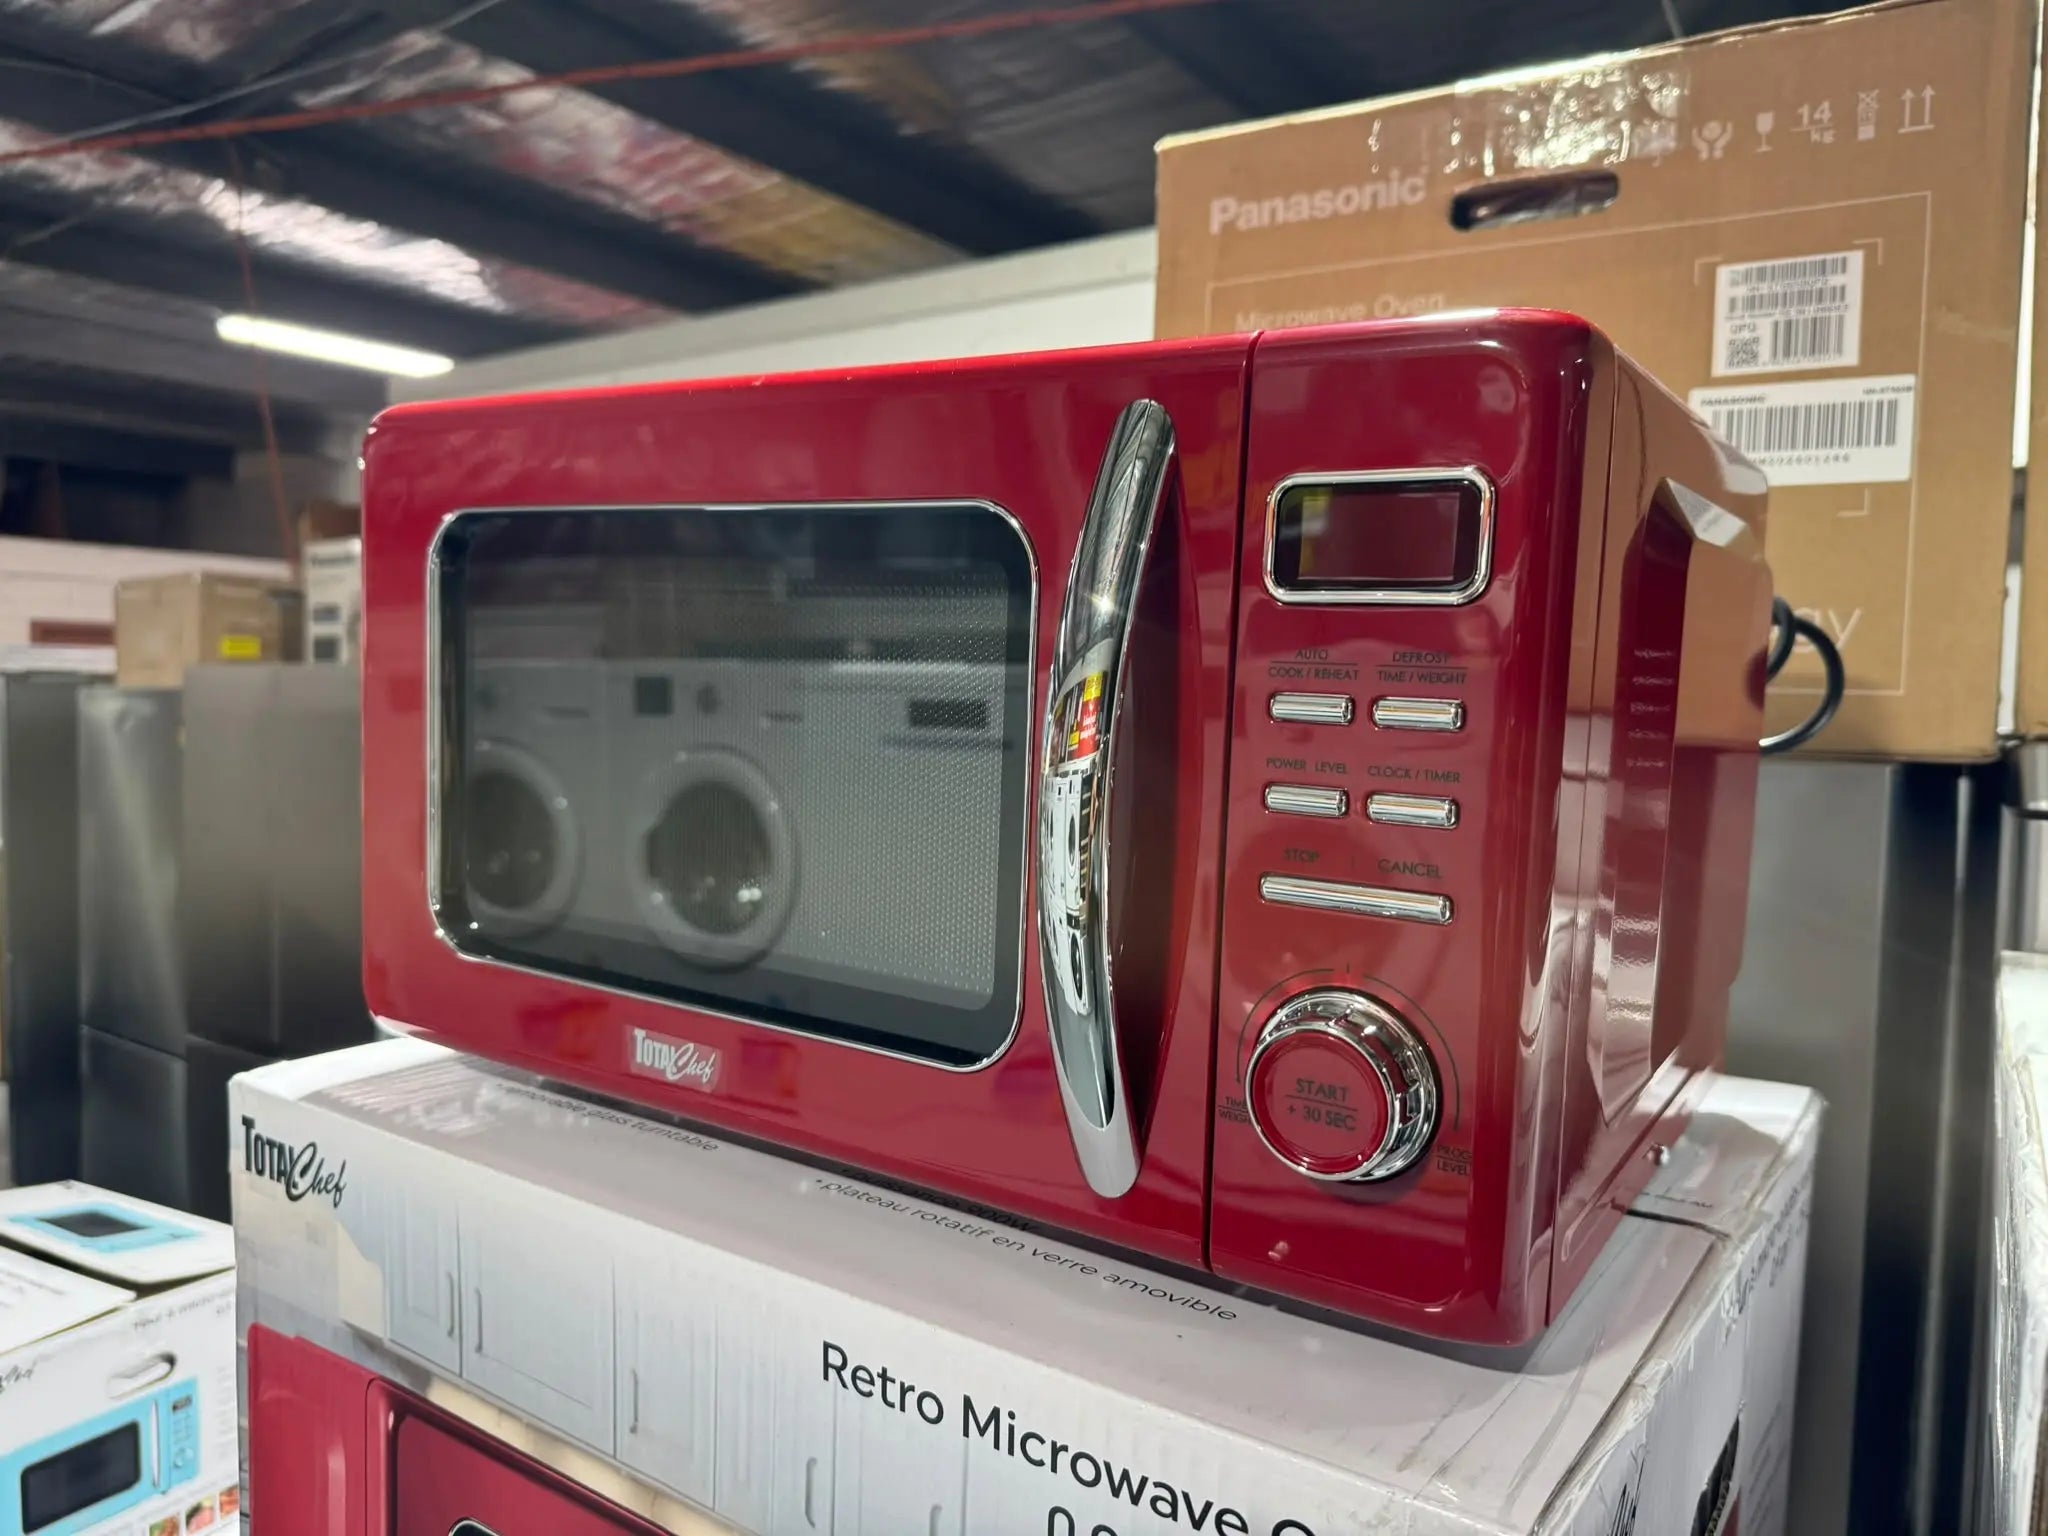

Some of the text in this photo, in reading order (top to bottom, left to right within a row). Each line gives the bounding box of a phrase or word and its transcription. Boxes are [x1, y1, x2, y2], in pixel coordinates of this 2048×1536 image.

[1797, 100, 1832, 128] 14
[1209, 168, 1427, 235] Panasonic
[1235, 293, 1448, 333] Microwave Oven
[1295, 649, 1449, 664] AUTO DEFROST
[1268, 667, 1305, 680] COOK
[1314, 668, 1360, 682] REHEAT
[1378, 671, 1409, 683] TIME
[1417, 672, 1467, 685] WEIGHT
[1266, 758, 1348, 774] POWER LEVEL
[1368, 766, 1411, 780] CLOCK
[1424, 769, 1461, 783] TIMER
[1284, 848, 1319, 863] STOP
[1378, 859, 1442, 878] CANCEL
[665, 1042, 716, 1084] Chef
[1296, 1078, 1349, 1102] START
[581, 1106, 629, 1126] glass
[629, 1120, 720, 1152] turntable
[1287, 1104, 1358, 1132] + 30 SEC
[285, 1140, 347, 1209] Chef
[820, 1180, 1239, 1321] plateau rotatif en verre amovible
[821, 1340, 1250, 1536] Retro Microwave
